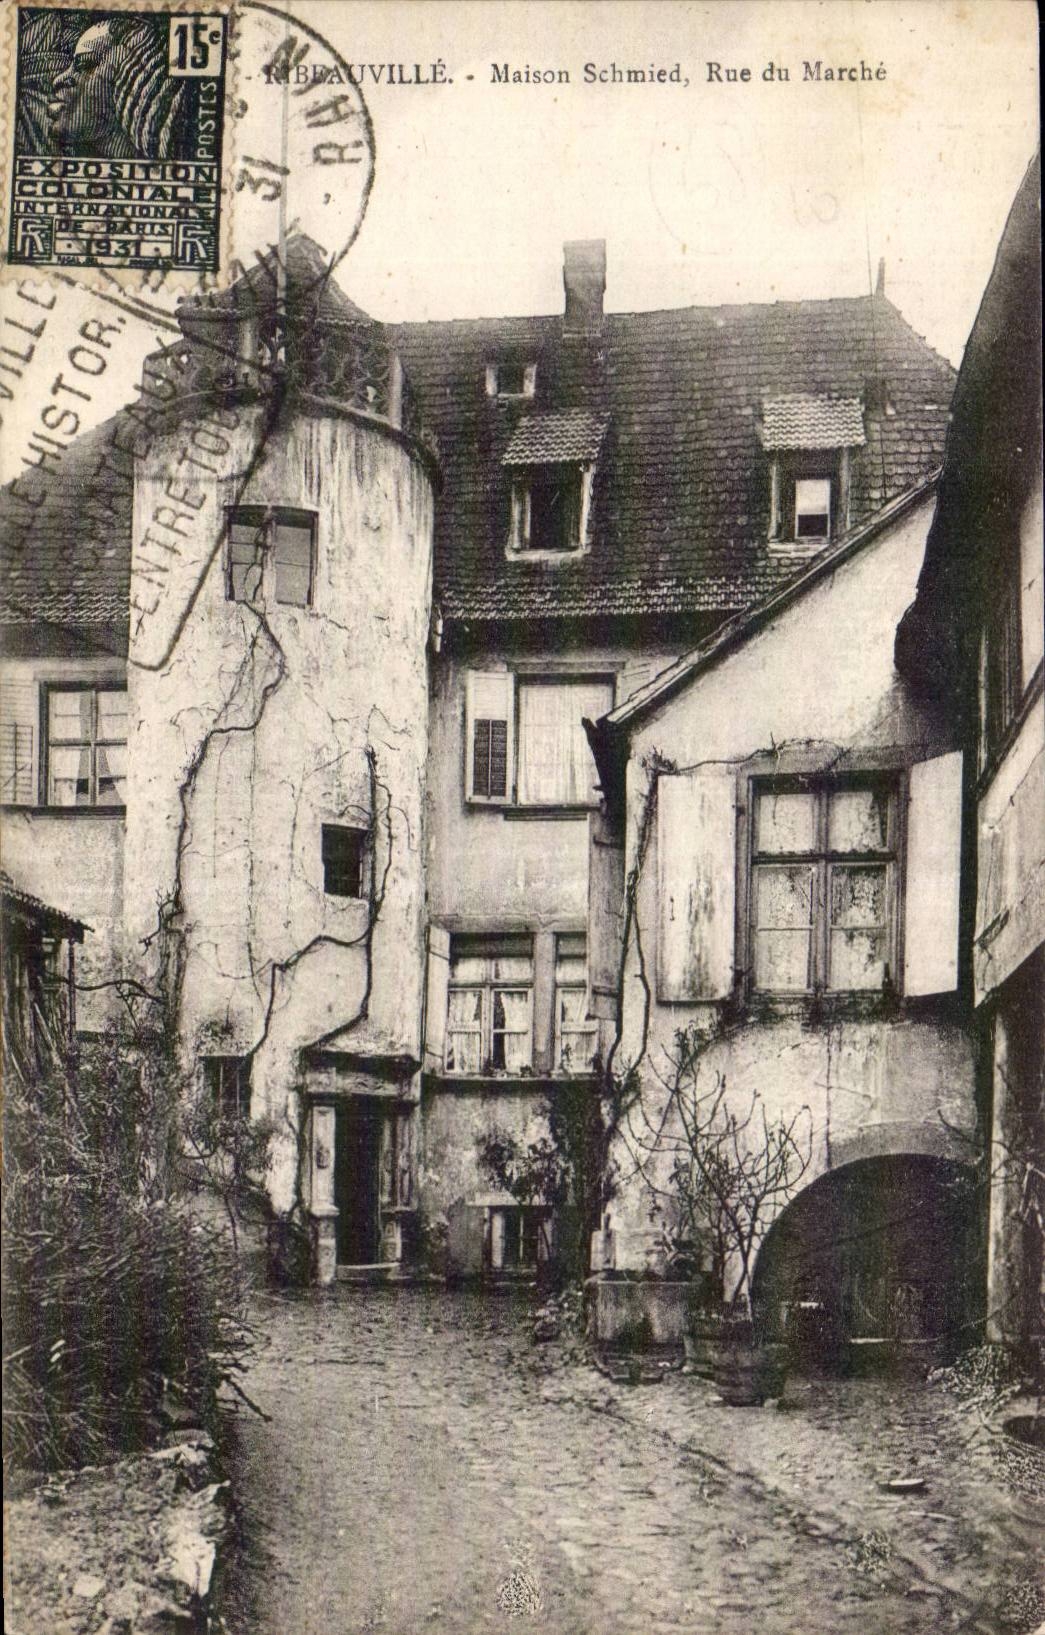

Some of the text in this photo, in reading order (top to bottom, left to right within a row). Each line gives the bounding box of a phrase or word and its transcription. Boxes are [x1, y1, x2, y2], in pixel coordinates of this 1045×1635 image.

[197, 81, 217, 159] POSTES
[18, 160, 216, 183] EXPOSITION
[17, 180, 215, 202] COLONIALE
[15, 201, 215, 218] INTERNATIONALE
[56, 219, 171, 234] DE PARIS
[84, 238, 143, 256] 1931
[20, 315, 127, 476] HISTOR.
